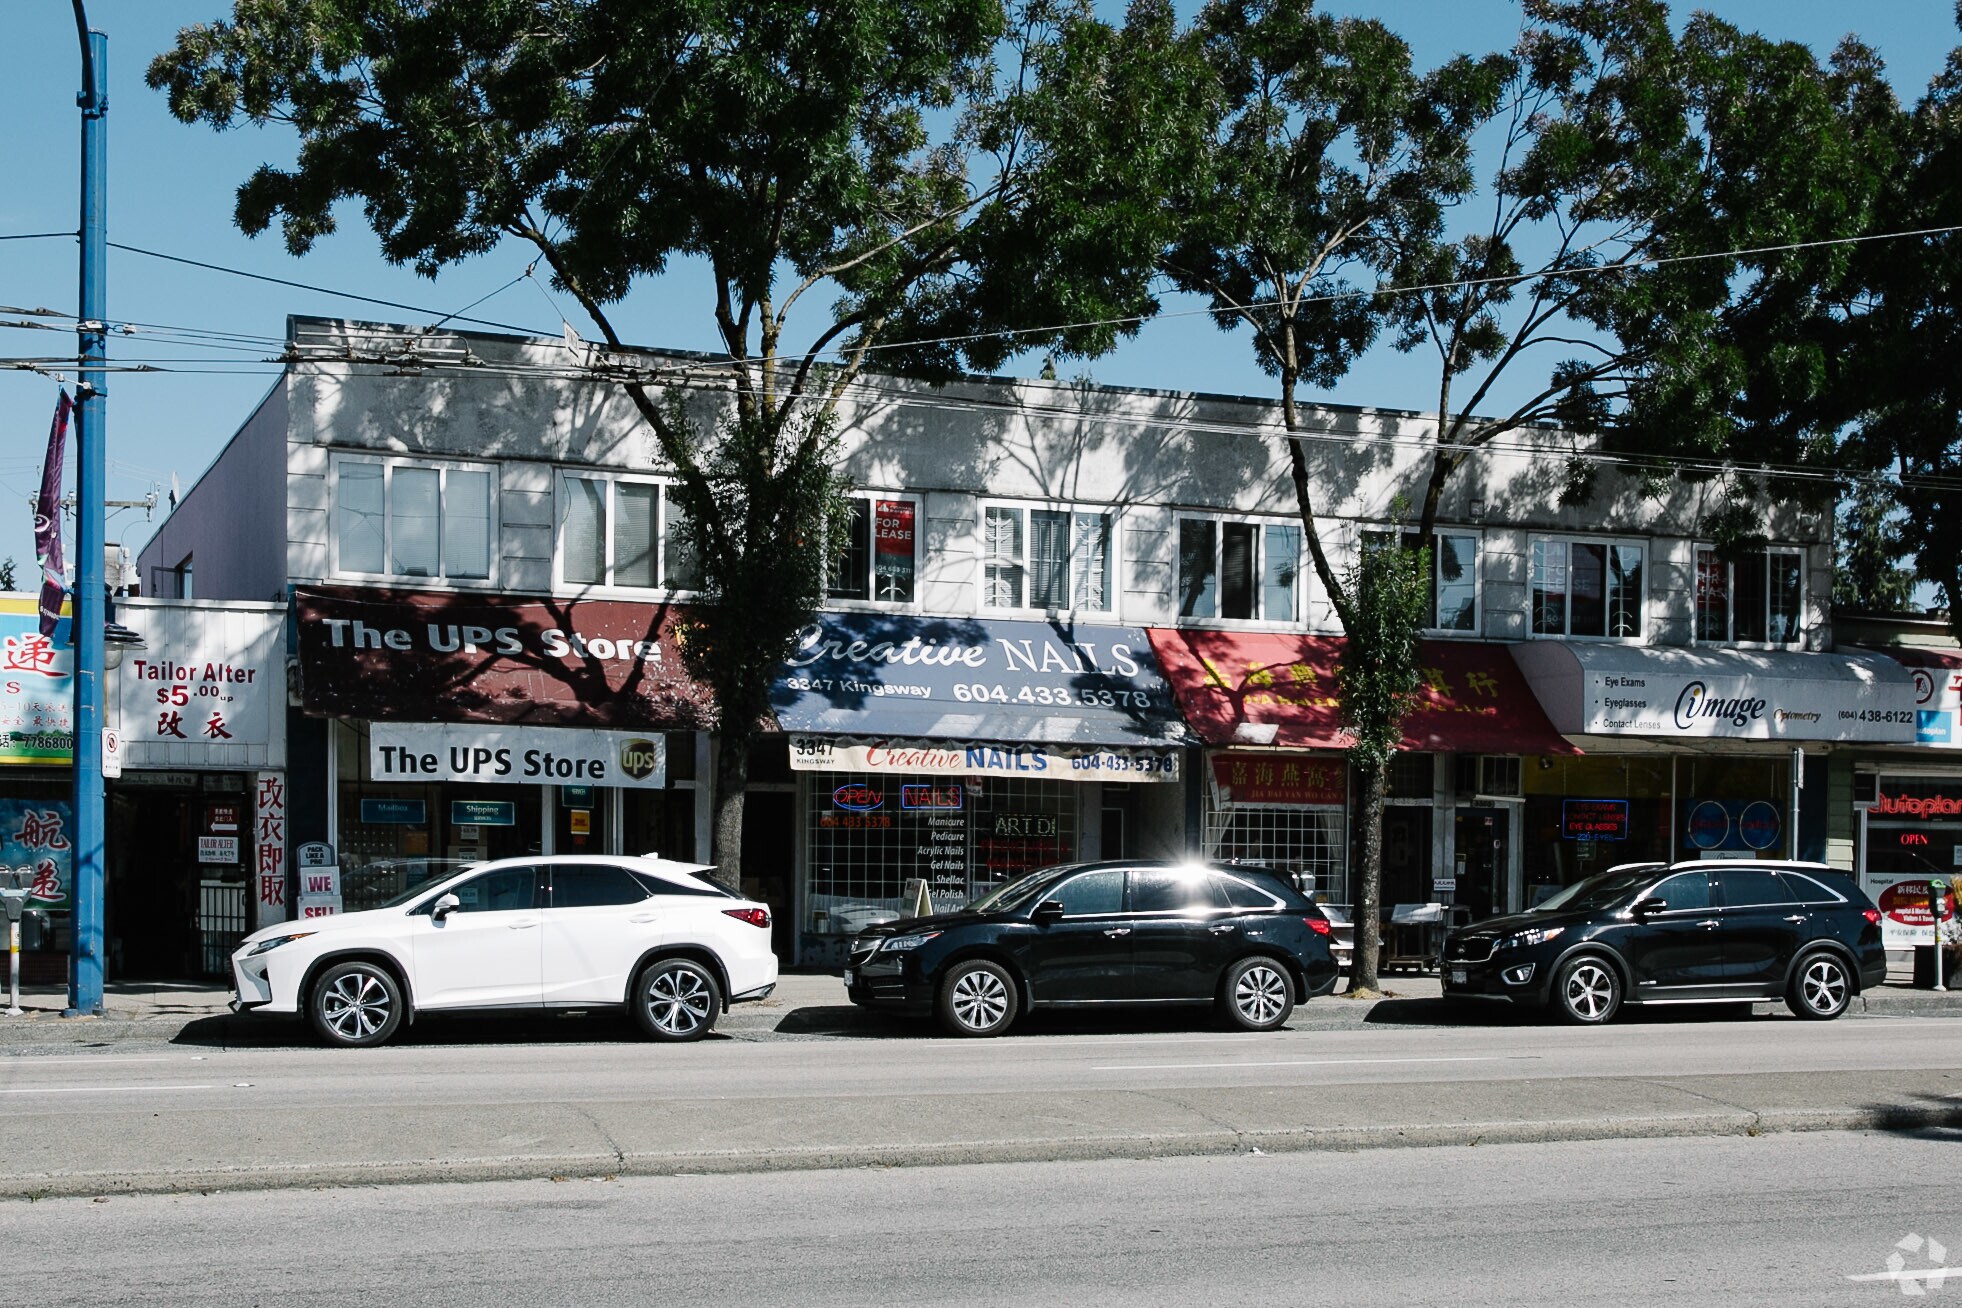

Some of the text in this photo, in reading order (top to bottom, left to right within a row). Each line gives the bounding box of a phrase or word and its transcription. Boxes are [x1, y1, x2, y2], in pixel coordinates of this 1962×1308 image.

[875, 518, 900, 528] FOR
[875, 529, 912, 540] LEASE
[322, 618, 662, 662] The UPS Store
[783, 623, 1139, 678] Creative NAILS
[134, 660, 256, 683] Tailor Alter
[1605, 676, 1646, 688] Eye Exams
[787, 677, 1151, 708] 3347 Kingsway 604.433.5378
[1604, 697, 1647, 709] Eyeglasses
[1773, 708, 1821, 723] Optometry
[1838, 710, 1858, 720] (604)
[1859, 710, 1913, 724] 438-6122
[1603, 718, 1661, 729] Contact Lenses
[796, 738, 836, 755] 3347
[866, 739, 961, 768] Creative
[966, 745, 1048, 771] NAILS
[379, 746, 606, 779] The UPS Store
[622, 751, 655, 775] ups
[834, 787, 959, 806] OPEN NAILS
[466, 805, 499, 815] Shipping
[842, 817, 861, 828] 433
[927, 816, 965, 827] Manicure
[259, 776, 284, 906] 改衣即取
[930, 831, 965, 841] Pedicure
[1900, 834, 1928, 845] OPEN
[917, 845, 964, 857] Acrylic Nails
[930, 860, 964, 870] Gel Nails
[308, 876, 332, 892] WE
[936, 874, 965, 885] Shellac
[939, 889, 964, 899] Polish
[933, 903, 950, 913] Nail
